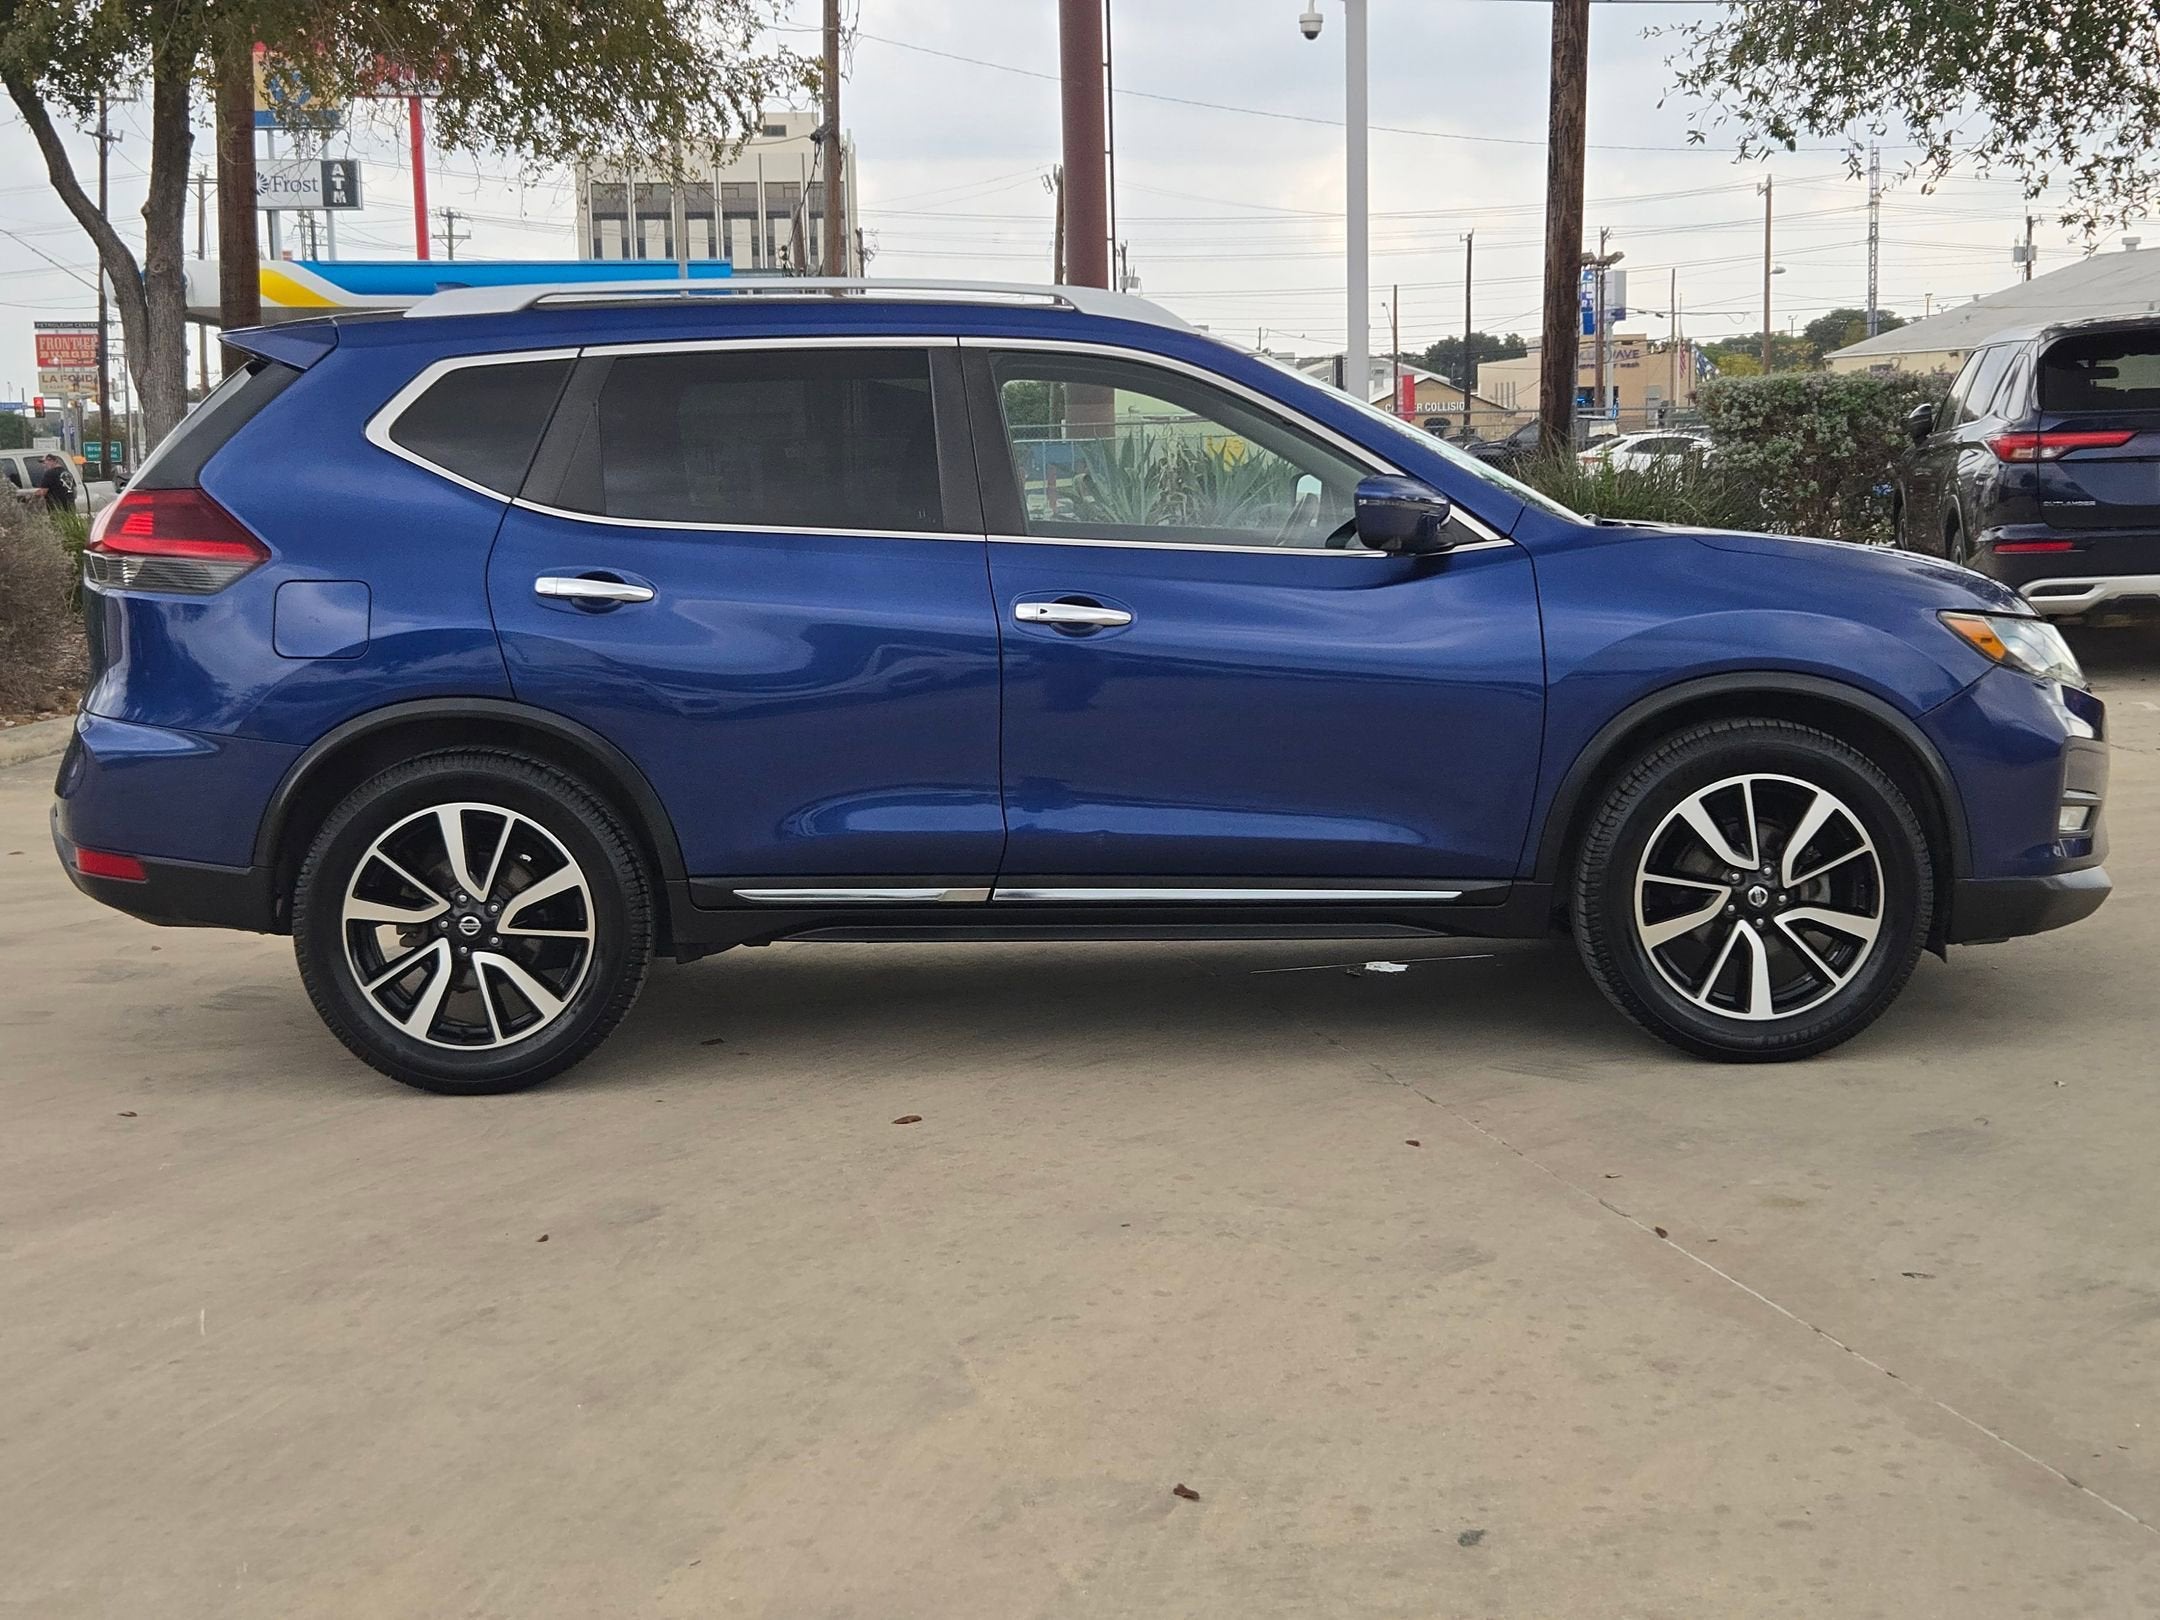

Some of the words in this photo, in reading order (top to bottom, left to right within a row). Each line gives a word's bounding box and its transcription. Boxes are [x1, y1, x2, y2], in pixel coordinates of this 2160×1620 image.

[271, 175, 318, 192] Frost
[331, 163, 347, 203] ATM
[42, 374, 57, 383] LA
[1425, 401, 1465, 412] COLLISIO
